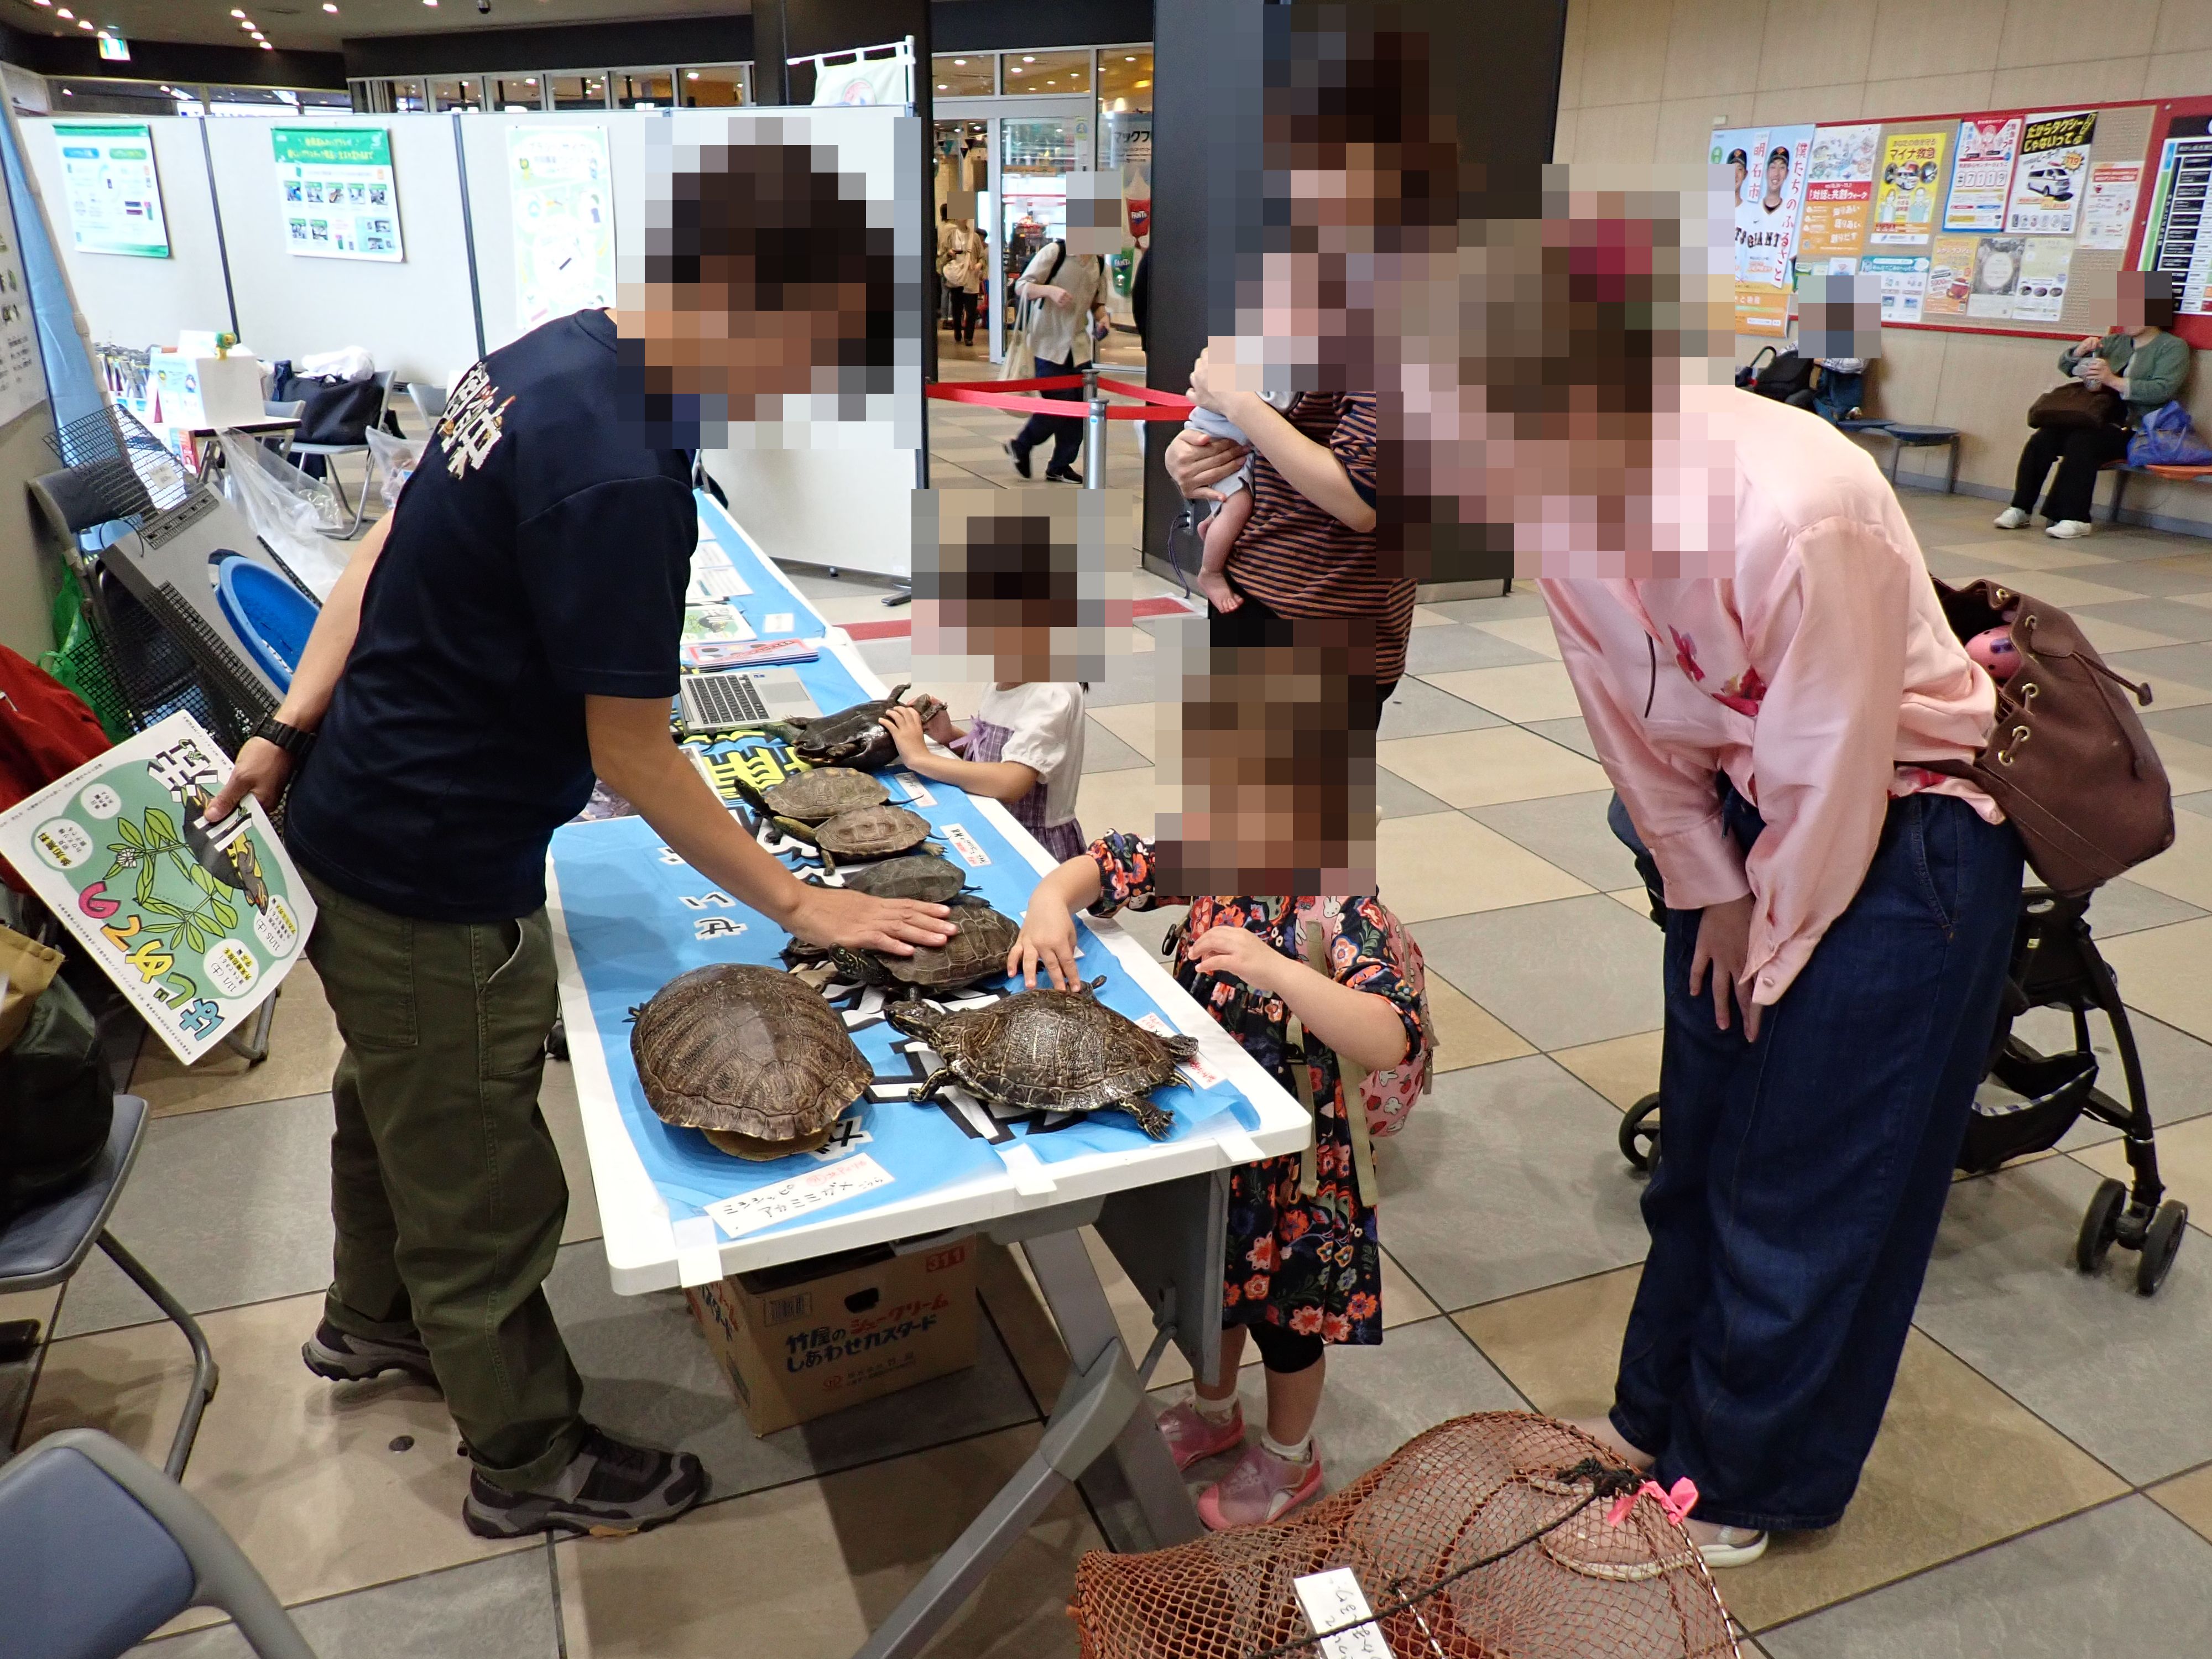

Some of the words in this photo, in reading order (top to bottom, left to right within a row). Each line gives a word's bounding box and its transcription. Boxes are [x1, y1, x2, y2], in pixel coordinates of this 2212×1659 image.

[2026, 118, 2084, 138] だからタクシー
[1747, 142, 1766, 199] 明石市
[1890, 148, 1935, 159] マイナ救急
[1773, 142, 1809, 281] 僕たちのふるさと
[1747, 231, 1782, 248] GIANT
[37, 831, 72, 869] 参加無料
[78, 881, 225, 1041] はじめての
[723, 1183, 795, 1215] ミシシッピ
[758, 1181, 853, 1218] アカミミガメ
[928, 1248, 964, 1271] 311
[786, 1292, 949, 1354] 竹屋のシュークリーム
[787, 1313, 937, 1373] しあわせカスタード
